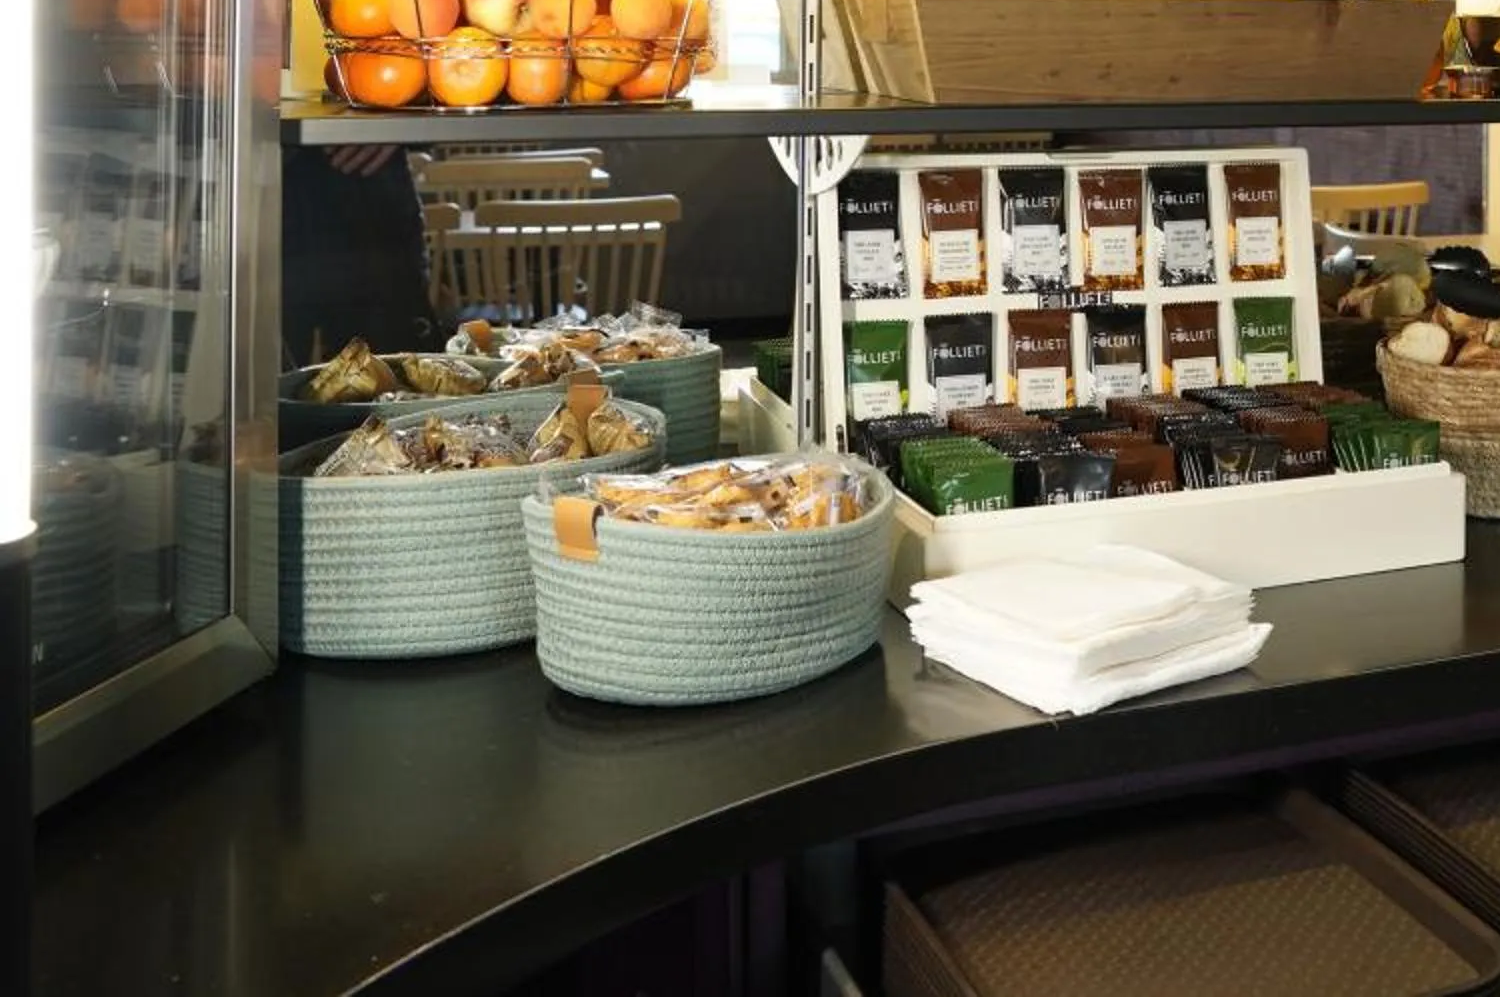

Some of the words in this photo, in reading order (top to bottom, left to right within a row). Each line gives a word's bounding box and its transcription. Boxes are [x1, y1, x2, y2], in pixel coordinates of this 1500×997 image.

[927, 199, 974, 214] FOLLIET
[1241, 323, 1284, 338] FOLLIET
[1015, 337, 1062, 352] FOLLIET
